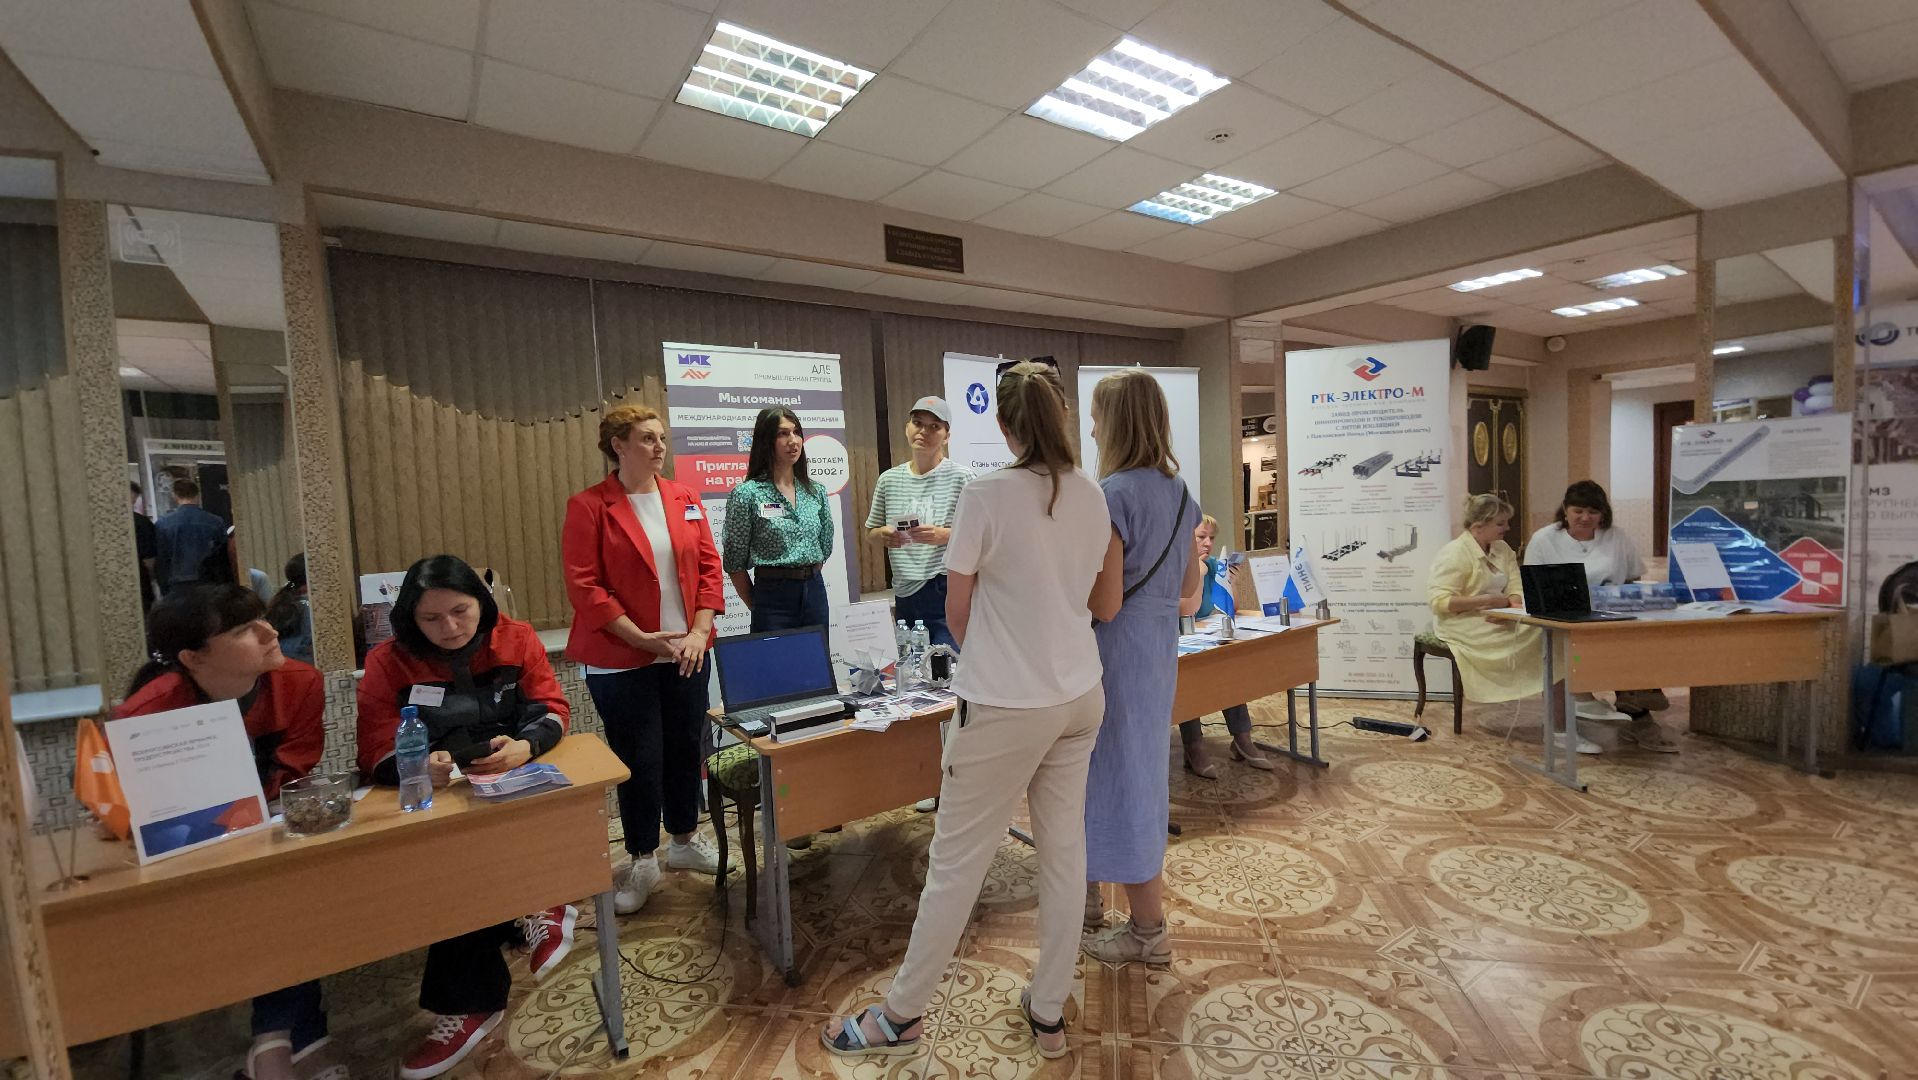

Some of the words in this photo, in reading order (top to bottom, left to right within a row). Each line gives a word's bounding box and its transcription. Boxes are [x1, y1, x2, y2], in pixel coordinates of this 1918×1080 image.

[718, 392, 741, 403] Мы
[742, 394, 801, 407] команда!
[695, 460, 748, 474] Пригла
[971, 460, 990, 468] Стань
[810, 467, 838, 476] 2002
[705, 476, 724, 486] на
[1860, 487, 1891, 496] МЗ
